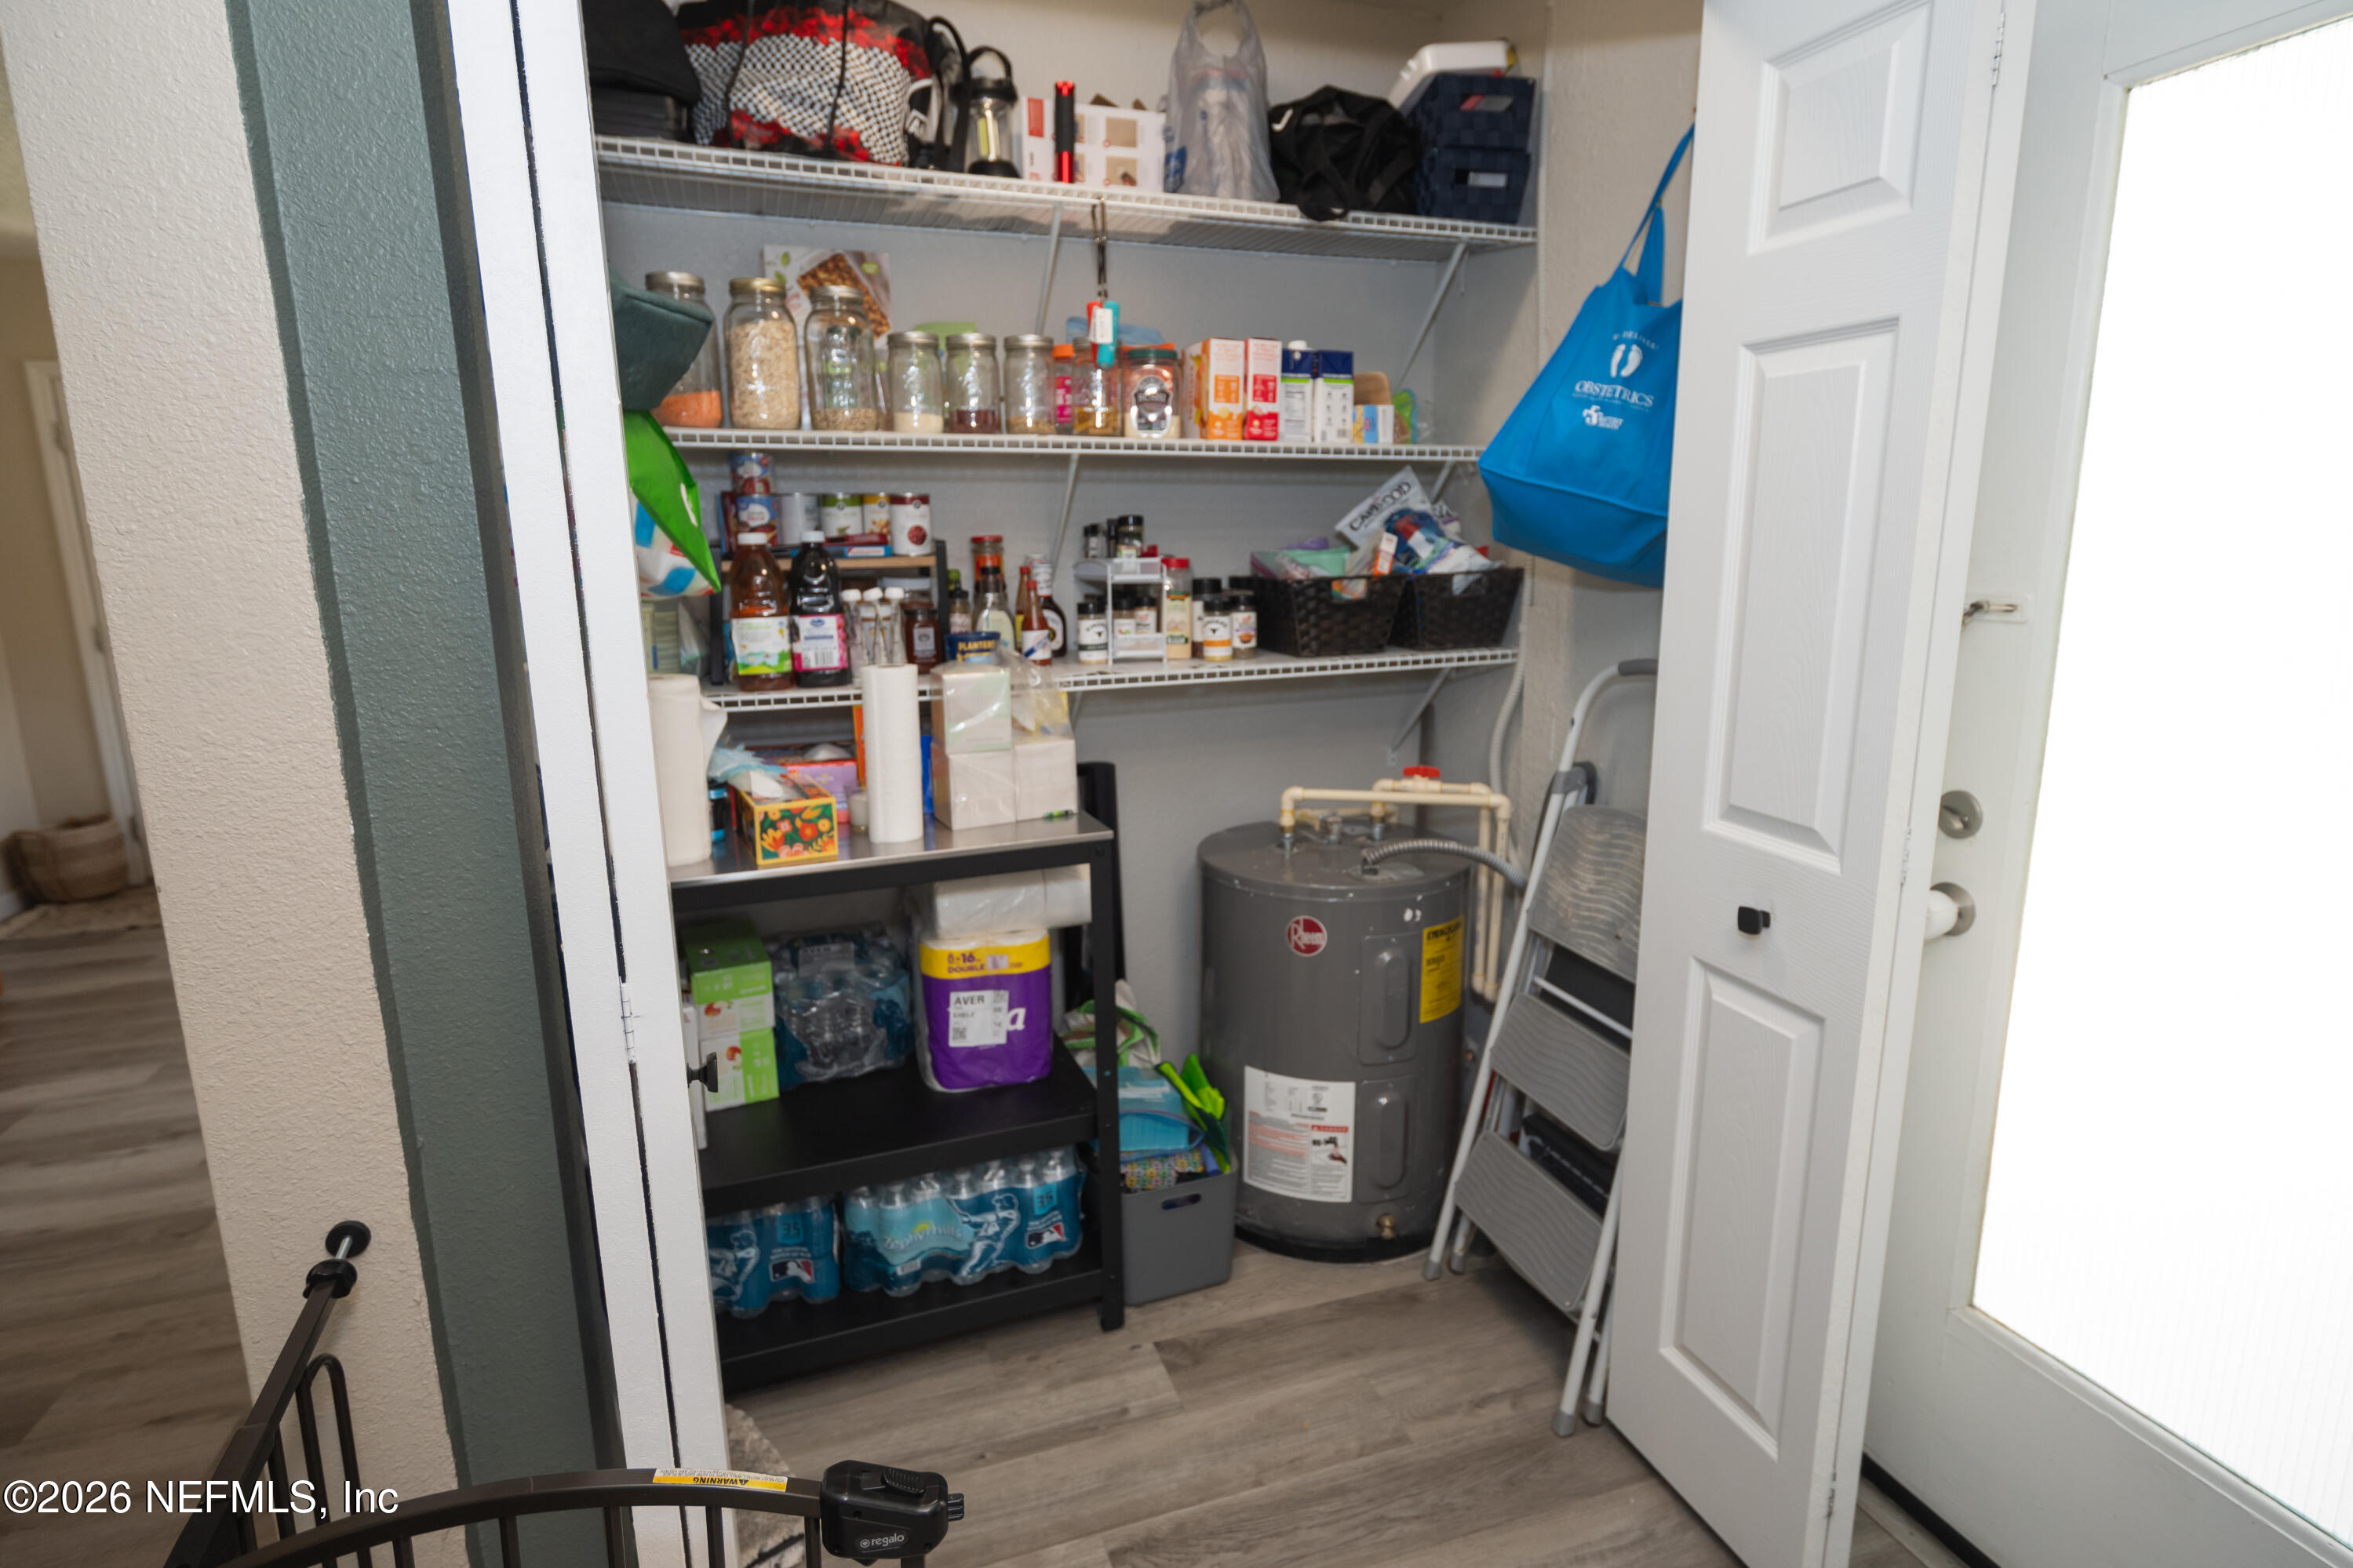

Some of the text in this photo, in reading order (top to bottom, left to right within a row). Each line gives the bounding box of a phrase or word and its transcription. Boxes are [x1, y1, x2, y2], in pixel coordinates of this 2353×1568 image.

[1574, 380, 1654, 407] OBSTETRICS
[1291, 918, 1325, 950] Rheem
[948, 964, 985, 973] DOUBLE
[953, 995, 985, 1006] AVER
[693, 1476, 738, 1486] WARNING
[871, 1533, 905, 1546] regalo
